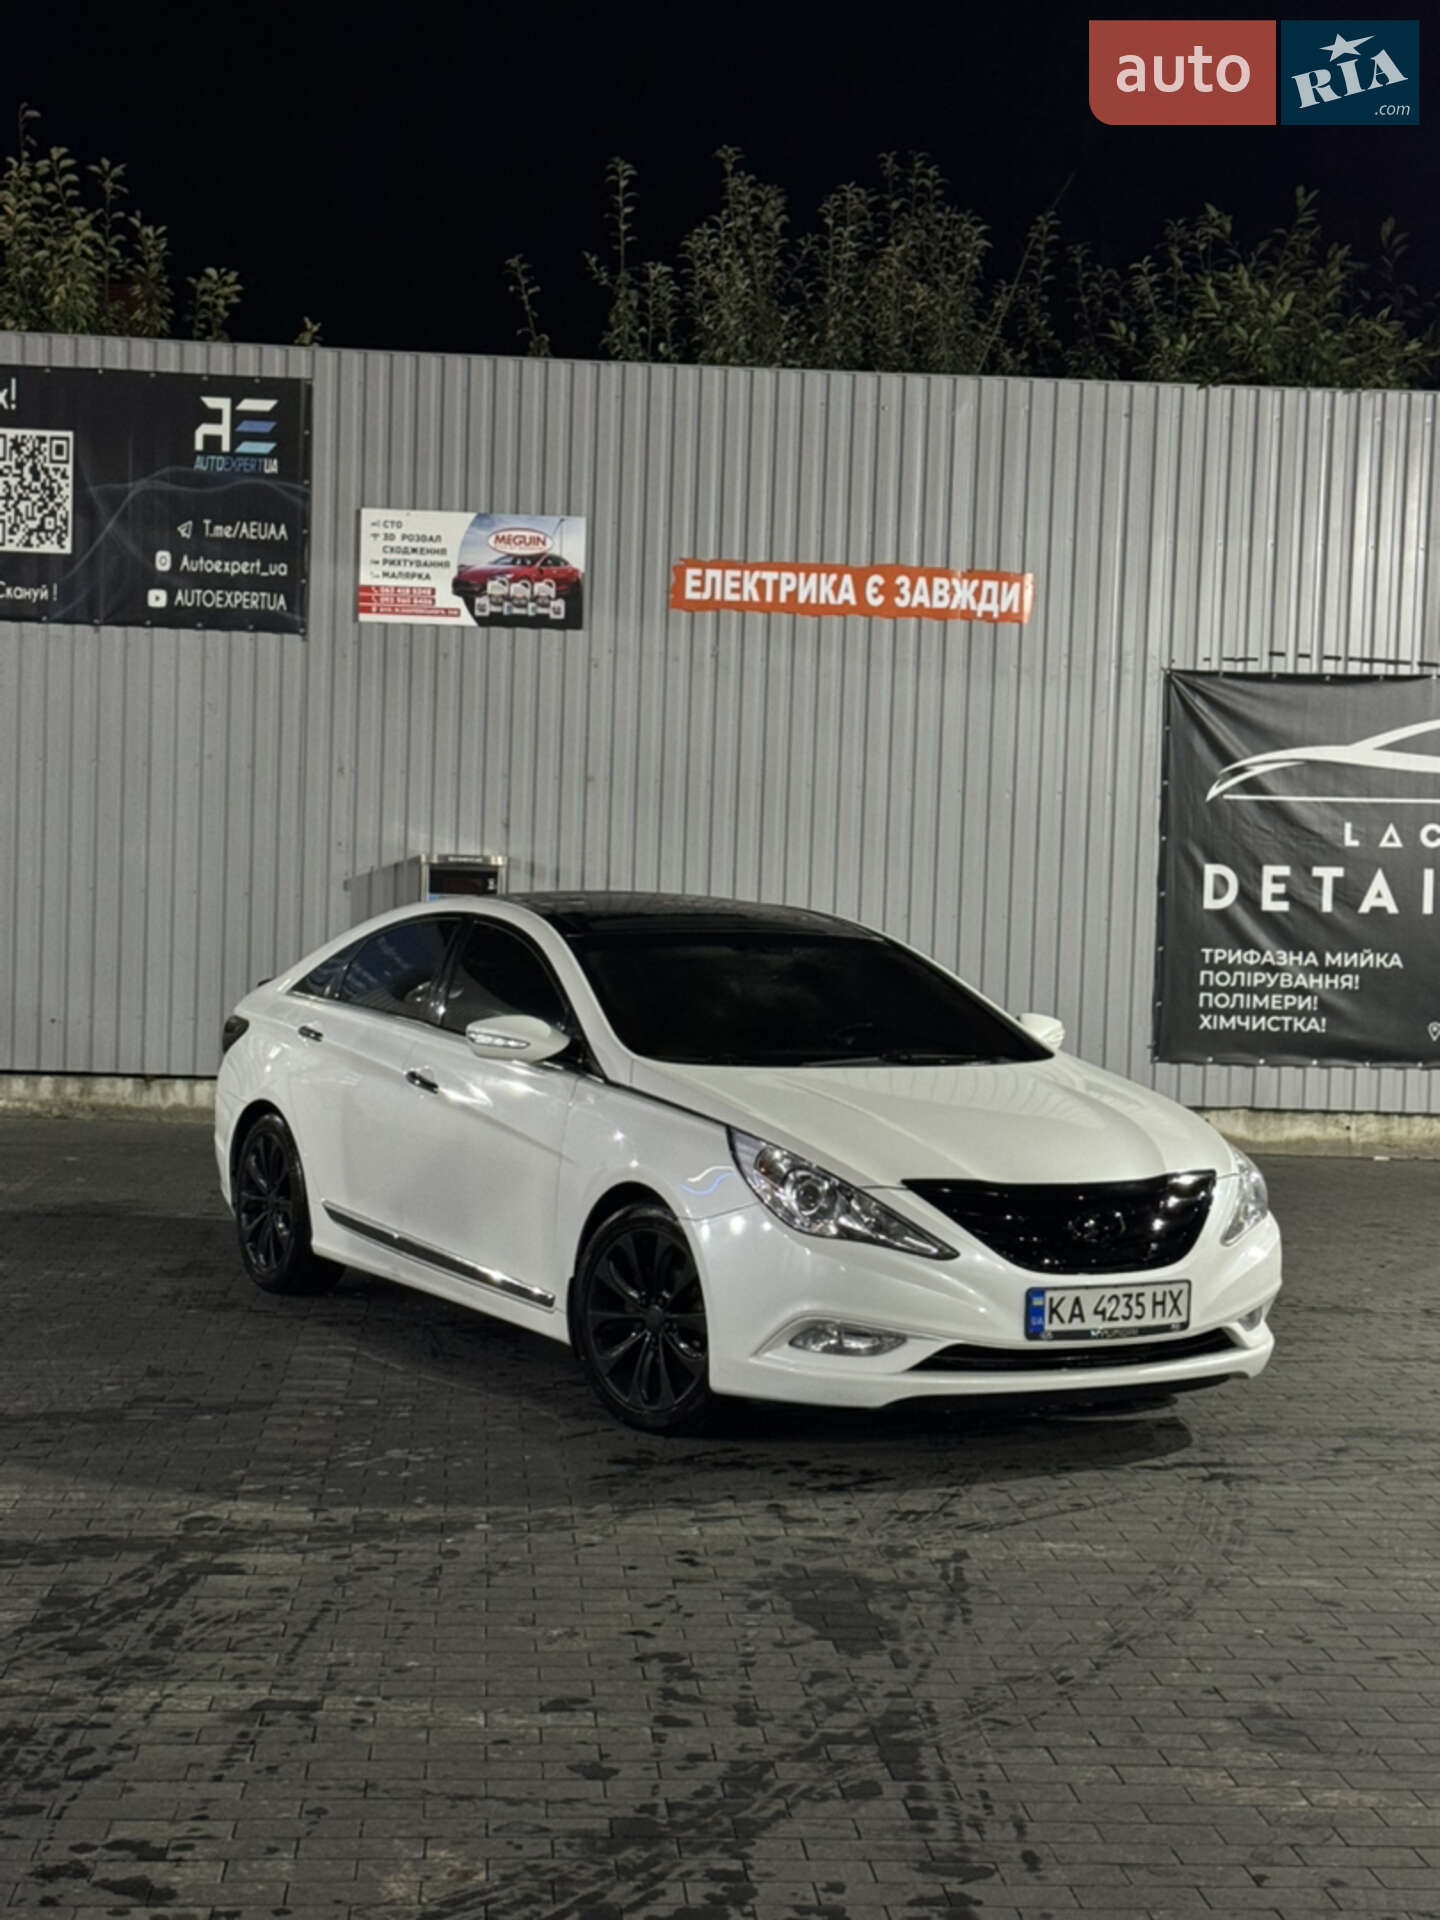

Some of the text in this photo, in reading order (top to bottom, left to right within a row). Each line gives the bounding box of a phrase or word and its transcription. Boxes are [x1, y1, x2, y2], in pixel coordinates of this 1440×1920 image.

[203, 518, 288, 540] T.me/AEUAA
[382, 520, 403, 529] СТО
[494, 534, 546, 547] MEGUIN
[180, 554, 288, 577] Autoexpert_ua
[684, 567, 857, 606] ЕЛЕКТРИКА
[864, 574, 885, 607] Є
[174, 588, 287, 611] AUTOEXPERTUA
[1203, 863, 1434, 915] DETAI
[1200, 948, 1404, 968] ТРИФАЗНА МИЙКА
[1199, 970, 1360, 990] ПОЛІРУВАННЯ!
[1198, 992, 1318, 1011] ПОЛІМЕРИ!
[1198, 1014, 1327, 1033] ХІМЧИСТКА!
[1048, 1289, 1184, 1325] KA 4235 HX
